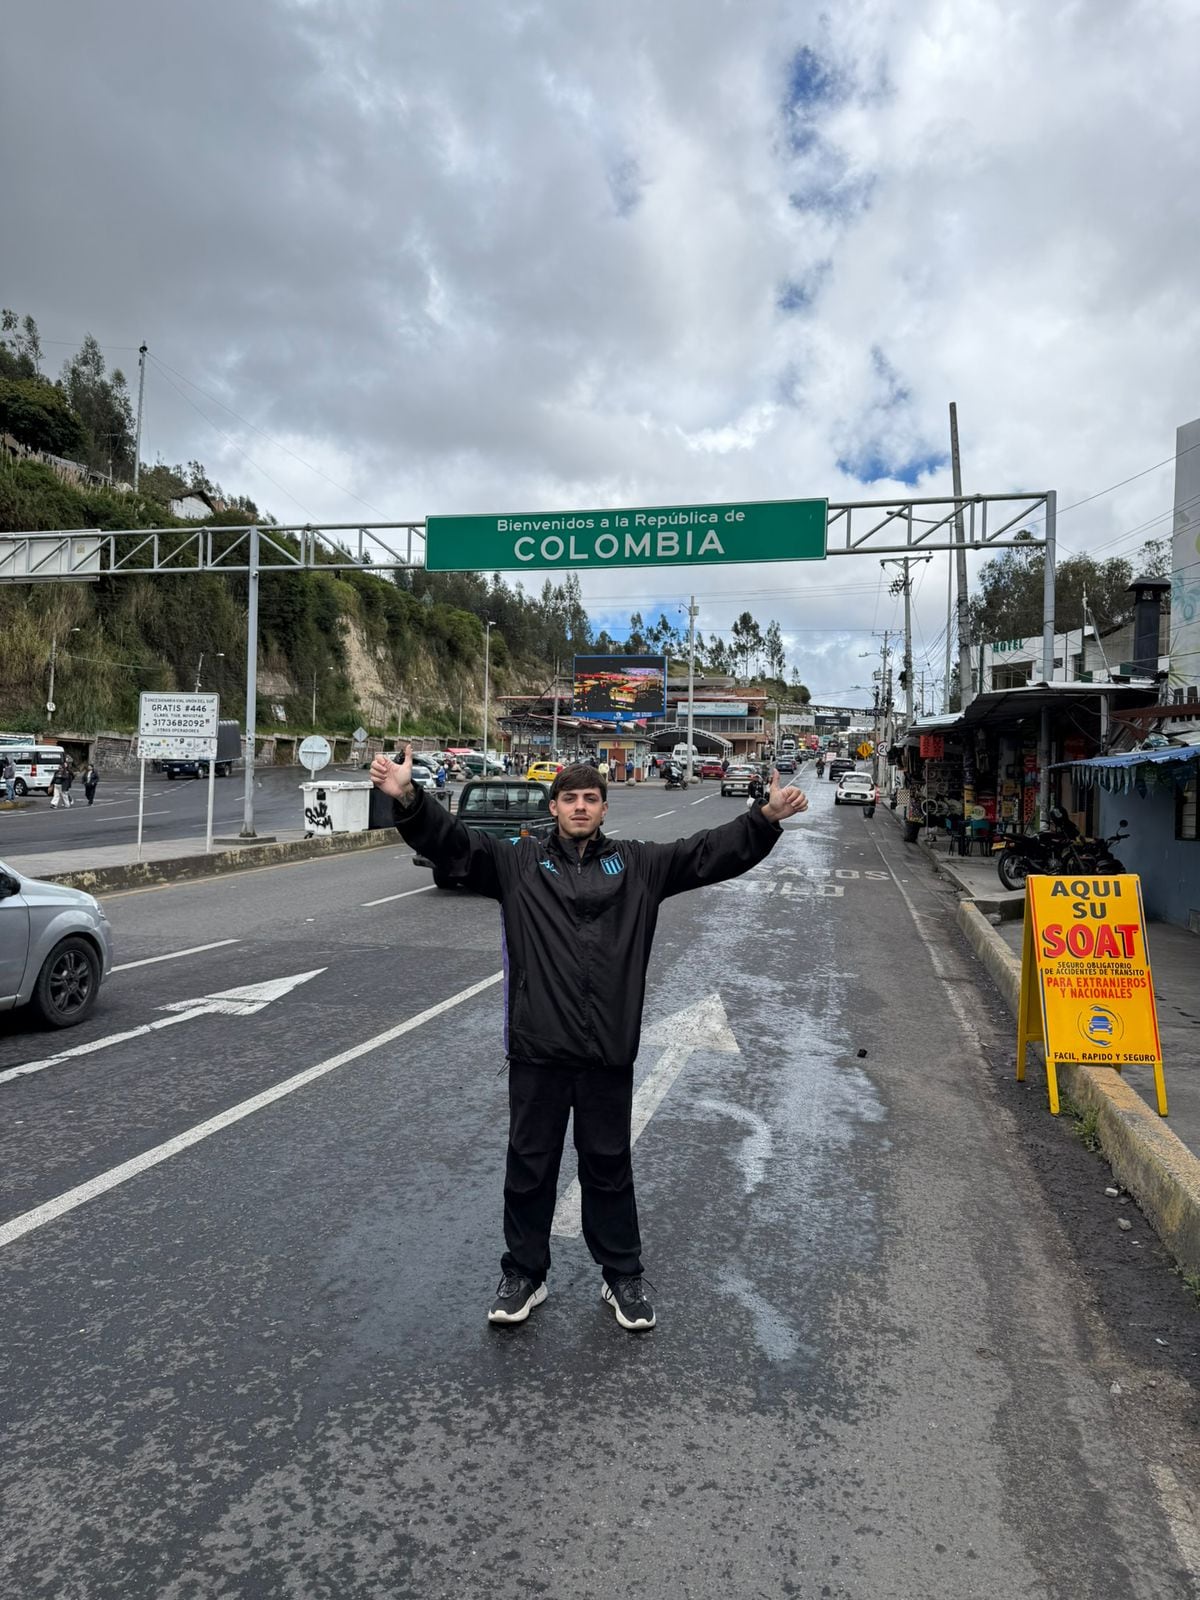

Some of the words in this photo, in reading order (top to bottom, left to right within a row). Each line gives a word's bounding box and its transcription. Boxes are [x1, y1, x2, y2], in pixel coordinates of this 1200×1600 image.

[496, 517, 595, 532] Bienvenidos
[600, 519, 610, 528] a
[614, 514, 630, 528] la
[634, 511, 720, 529] República
[724, 510, 746, 523] de
[513, 529, 726, 562] COLOMBIA
[993, 638, 1023, 653] HOTEL
[152, 704, 181, 712] GRATIS
[152, 718, 205, 727] 3173682092
[747, 866, 890, 880] SADOS
[1051, 880, 1122, 900] AQUI
[1072, 902, 1107, 919] SU
[1043, 924, 1139, 958] SOAT
[1046, 977, 1072, 988] PARA
[1076, 977, 1146, 988] EXTRANJEROS
[1060, 988, 1066, 998] Y
[1070, 988, 1133, 999] NACIONALES
[1054, 1052, 1080, 1061] FACIL,
[1082, 1052, 1113, 1061] RAPIDO
[1115, 1053, 1121, 1061] Y
[1123, 1054, 1156, 1062] SEGURO
